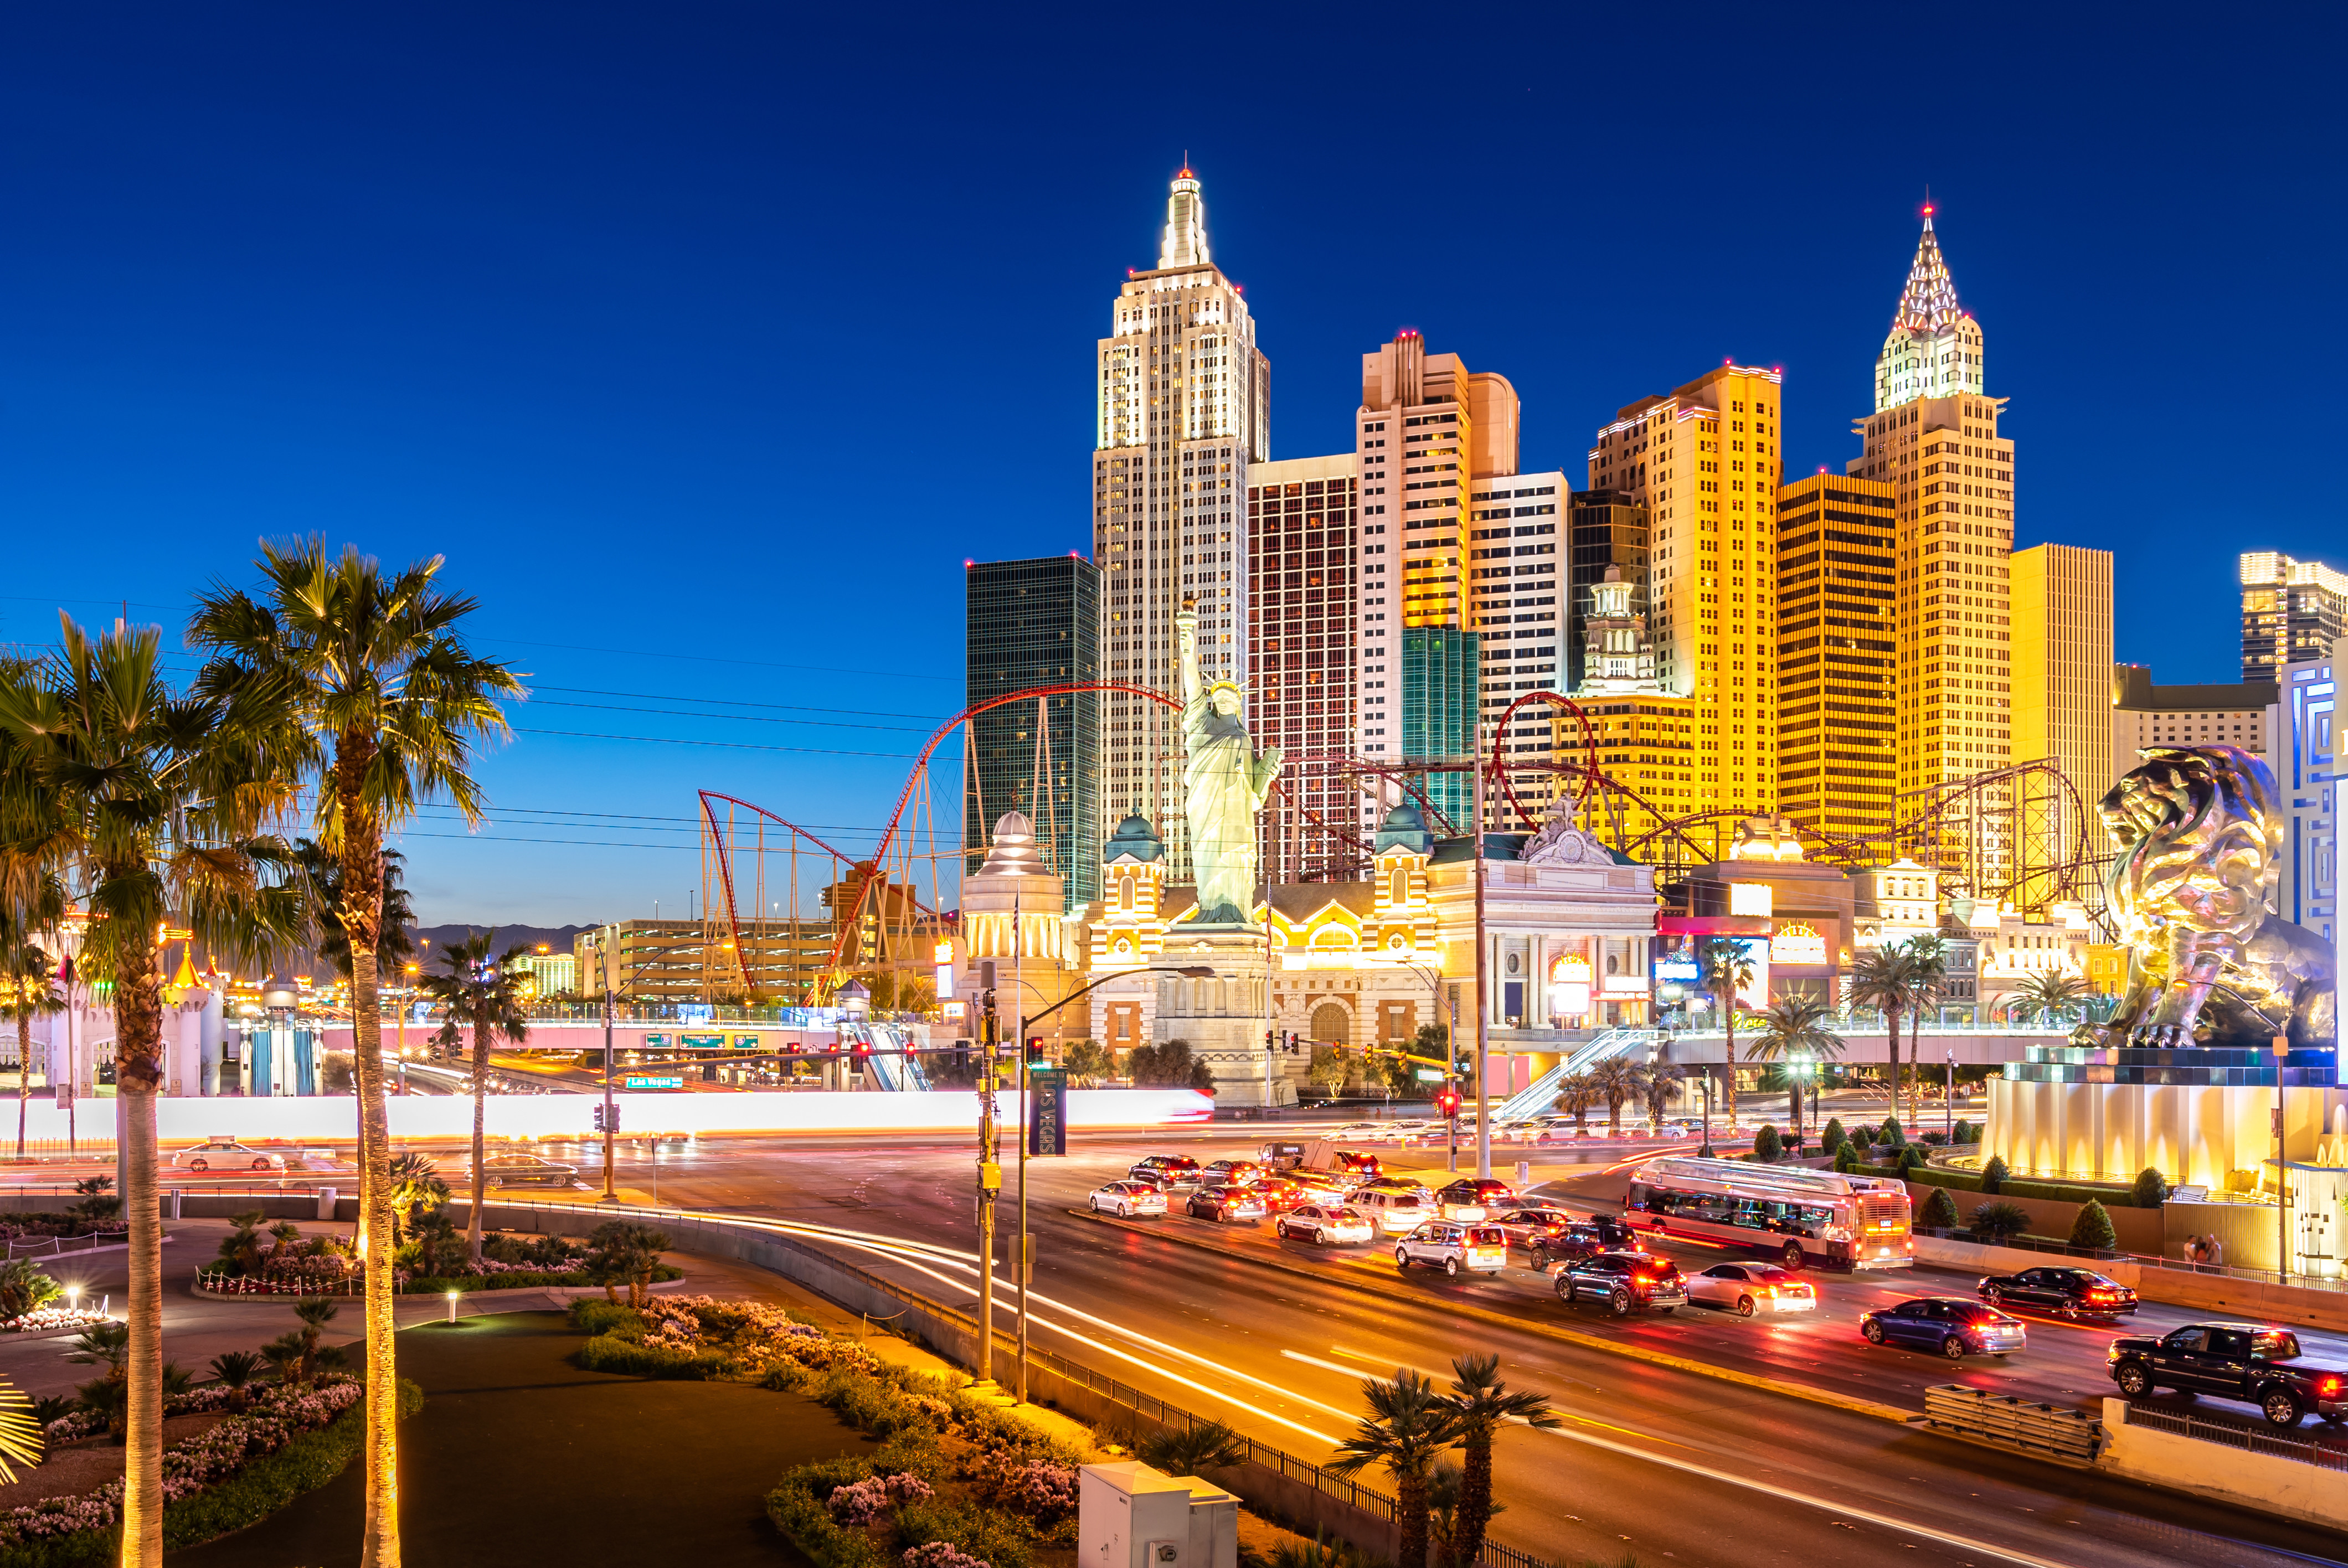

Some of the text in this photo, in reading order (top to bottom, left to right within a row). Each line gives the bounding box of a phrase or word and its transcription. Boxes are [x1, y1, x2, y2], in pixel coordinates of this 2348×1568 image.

[647, 1078, 671, 1087] Vegas
[1039, 1081, 1056, 1153] LAS VEGAS
